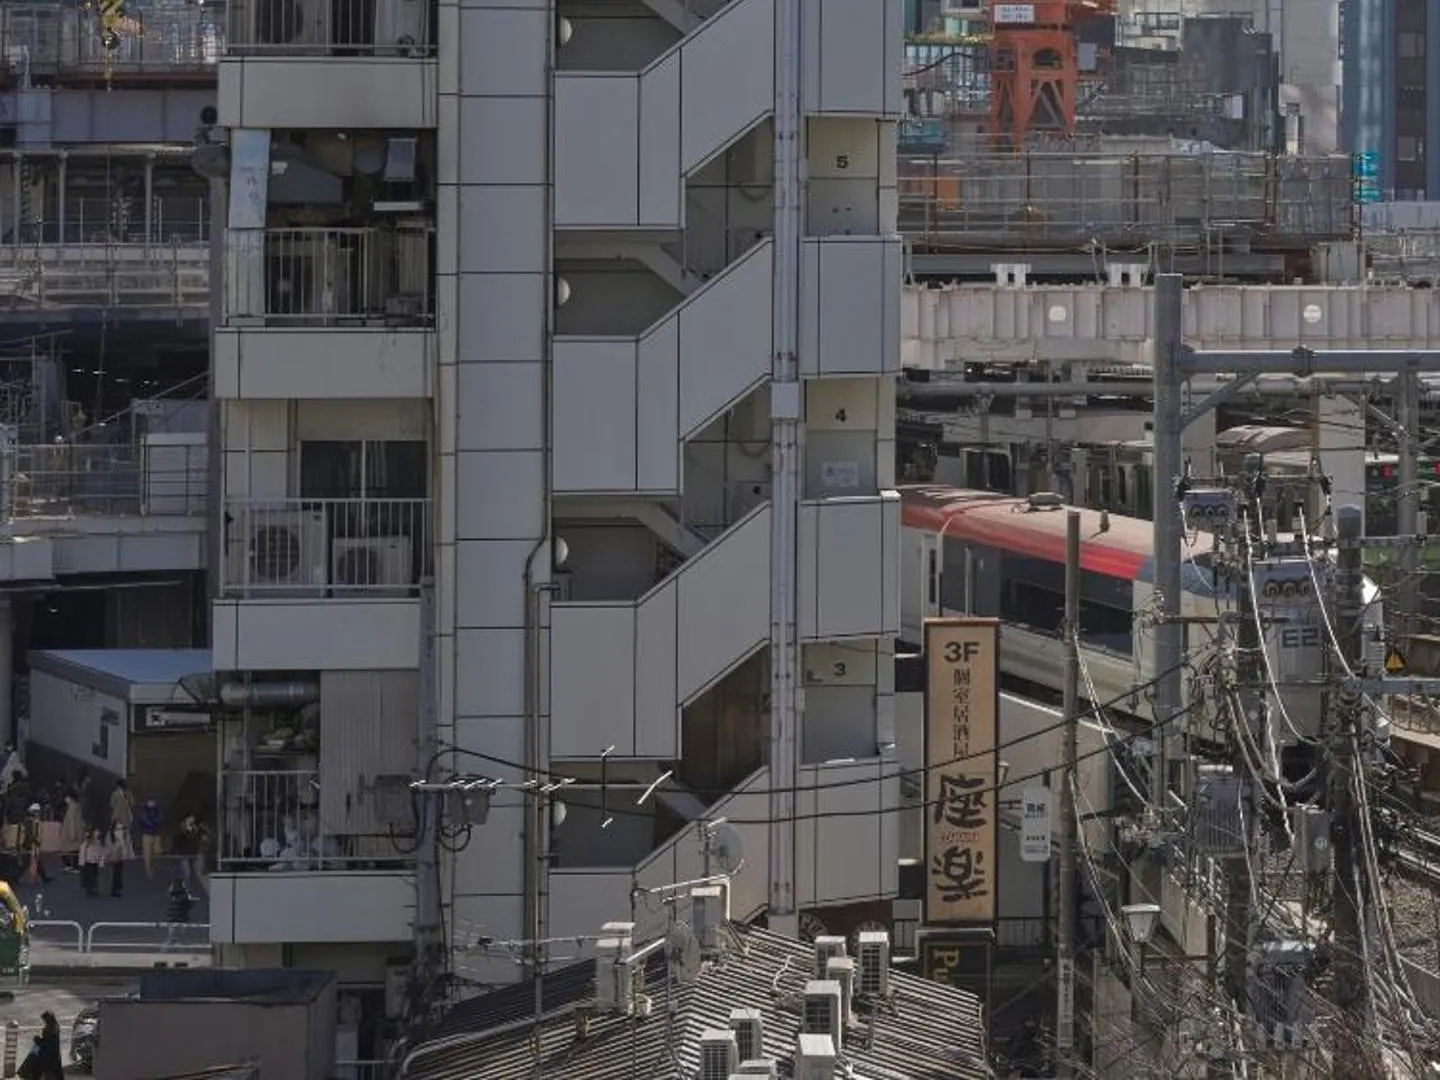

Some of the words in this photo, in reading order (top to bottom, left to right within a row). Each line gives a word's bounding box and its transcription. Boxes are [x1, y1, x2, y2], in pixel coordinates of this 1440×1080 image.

[836, 155, 849, 169] 5
[835, 409, 846, 423] 4
[943, 641, 980, 663] 3F
[835, 662, 846, 676] 3
